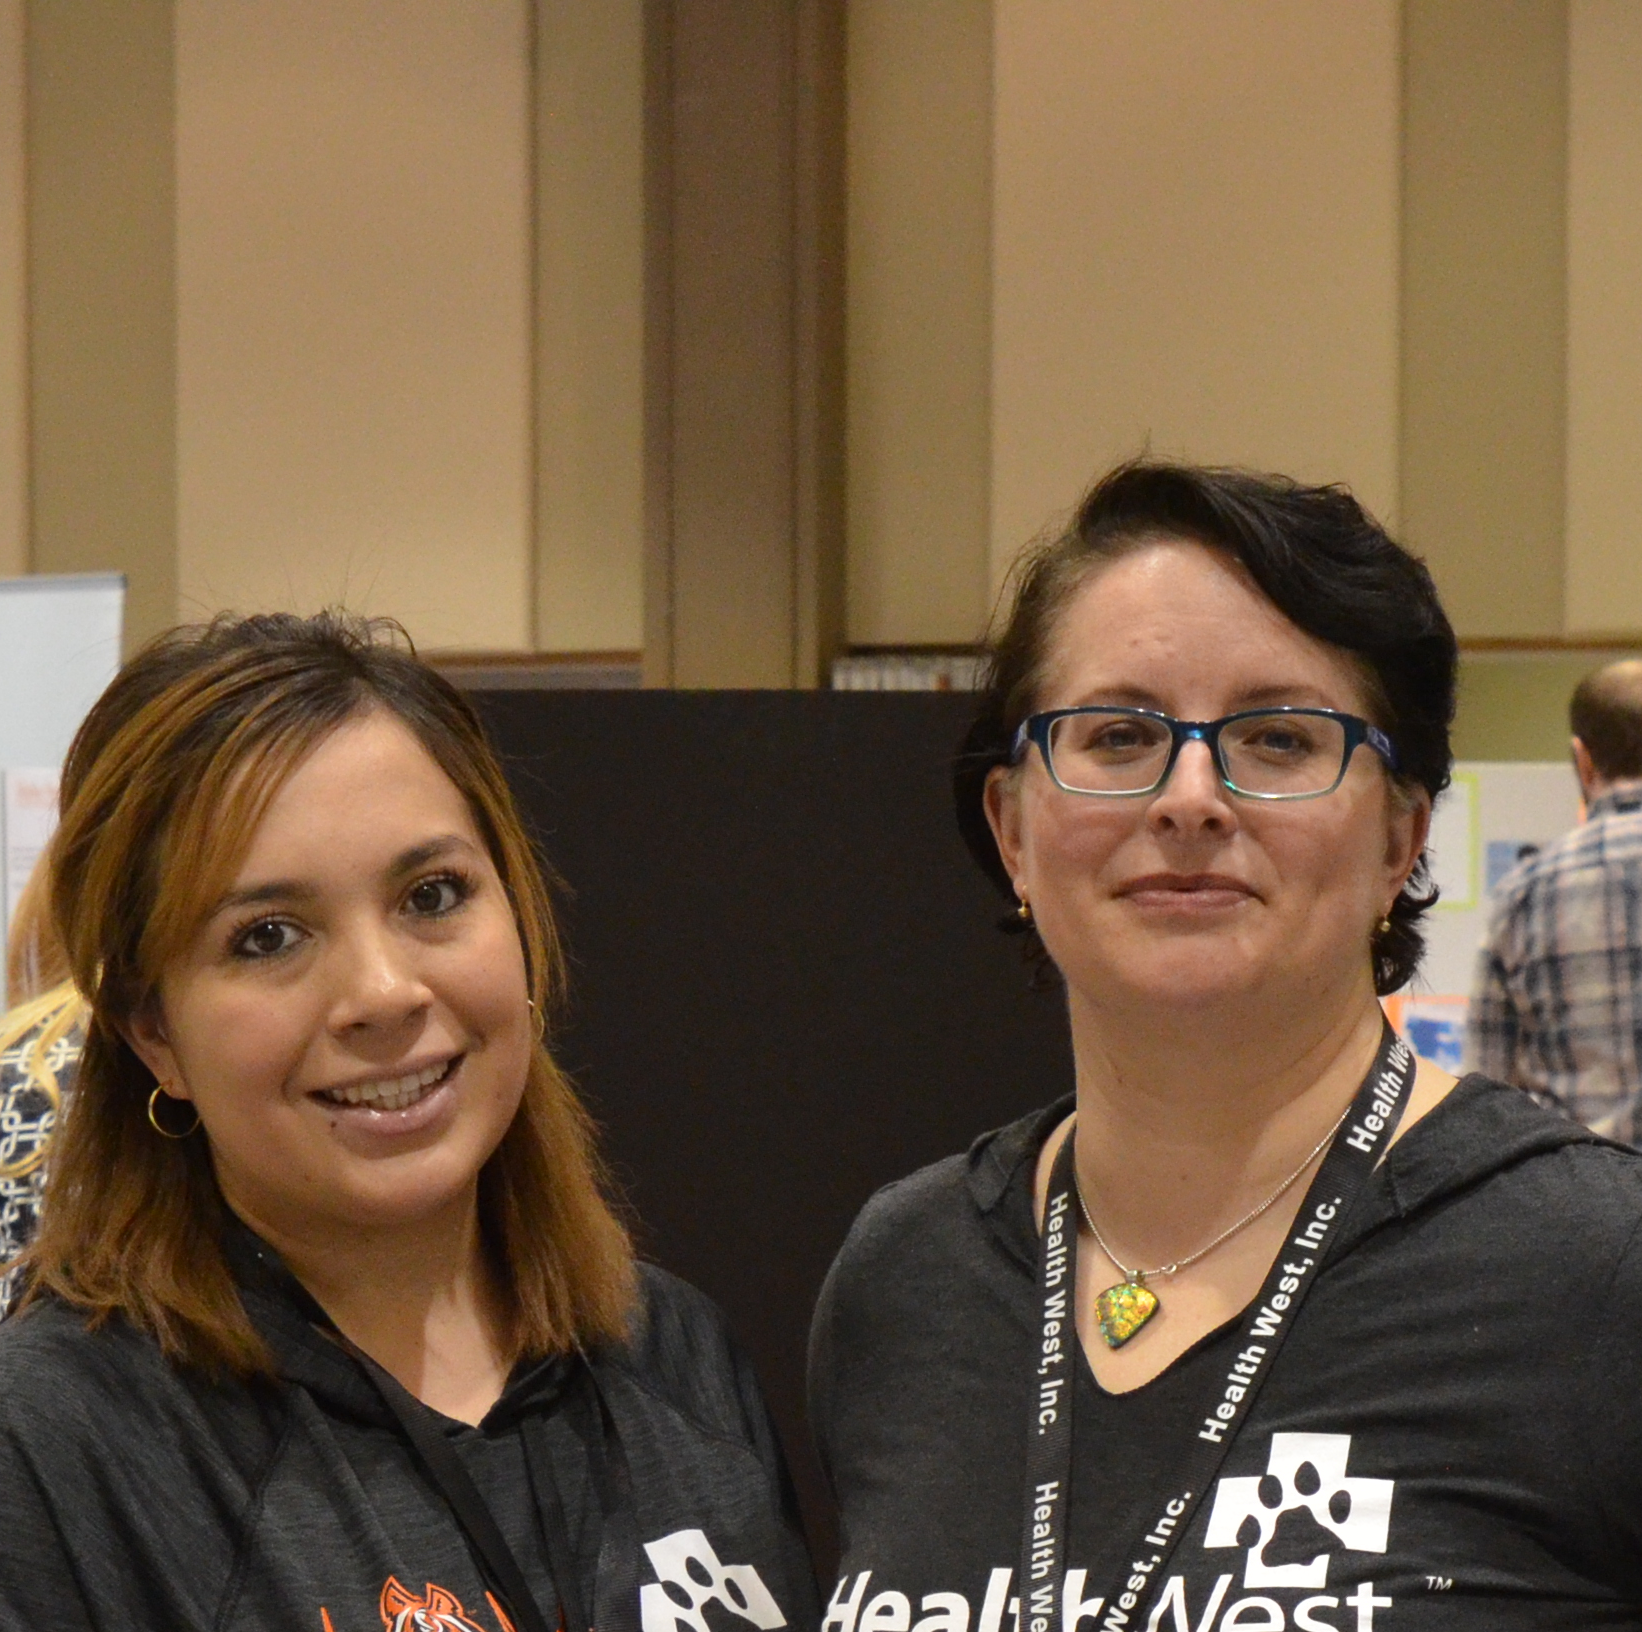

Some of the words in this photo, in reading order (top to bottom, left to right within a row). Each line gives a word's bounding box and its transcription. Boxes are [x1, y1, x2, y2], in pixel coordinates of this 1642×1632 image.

[1347, 1072, 1404, 1153] Health
[1041, 1191, 1068, 1288] Health
[1037, 1289, 1066, 1374] West,
[1199, 1339, 1267, 1443] Health
[1254, 1253, 1315, 1338] West,
[1305, 1197, 1343, 1253] Inc.
[1038, 1378, 1064, 1435] Inc.
[1030, 1480, 1059, 1579] Health
[1148, 1490, 1193, 1552] Inc.
